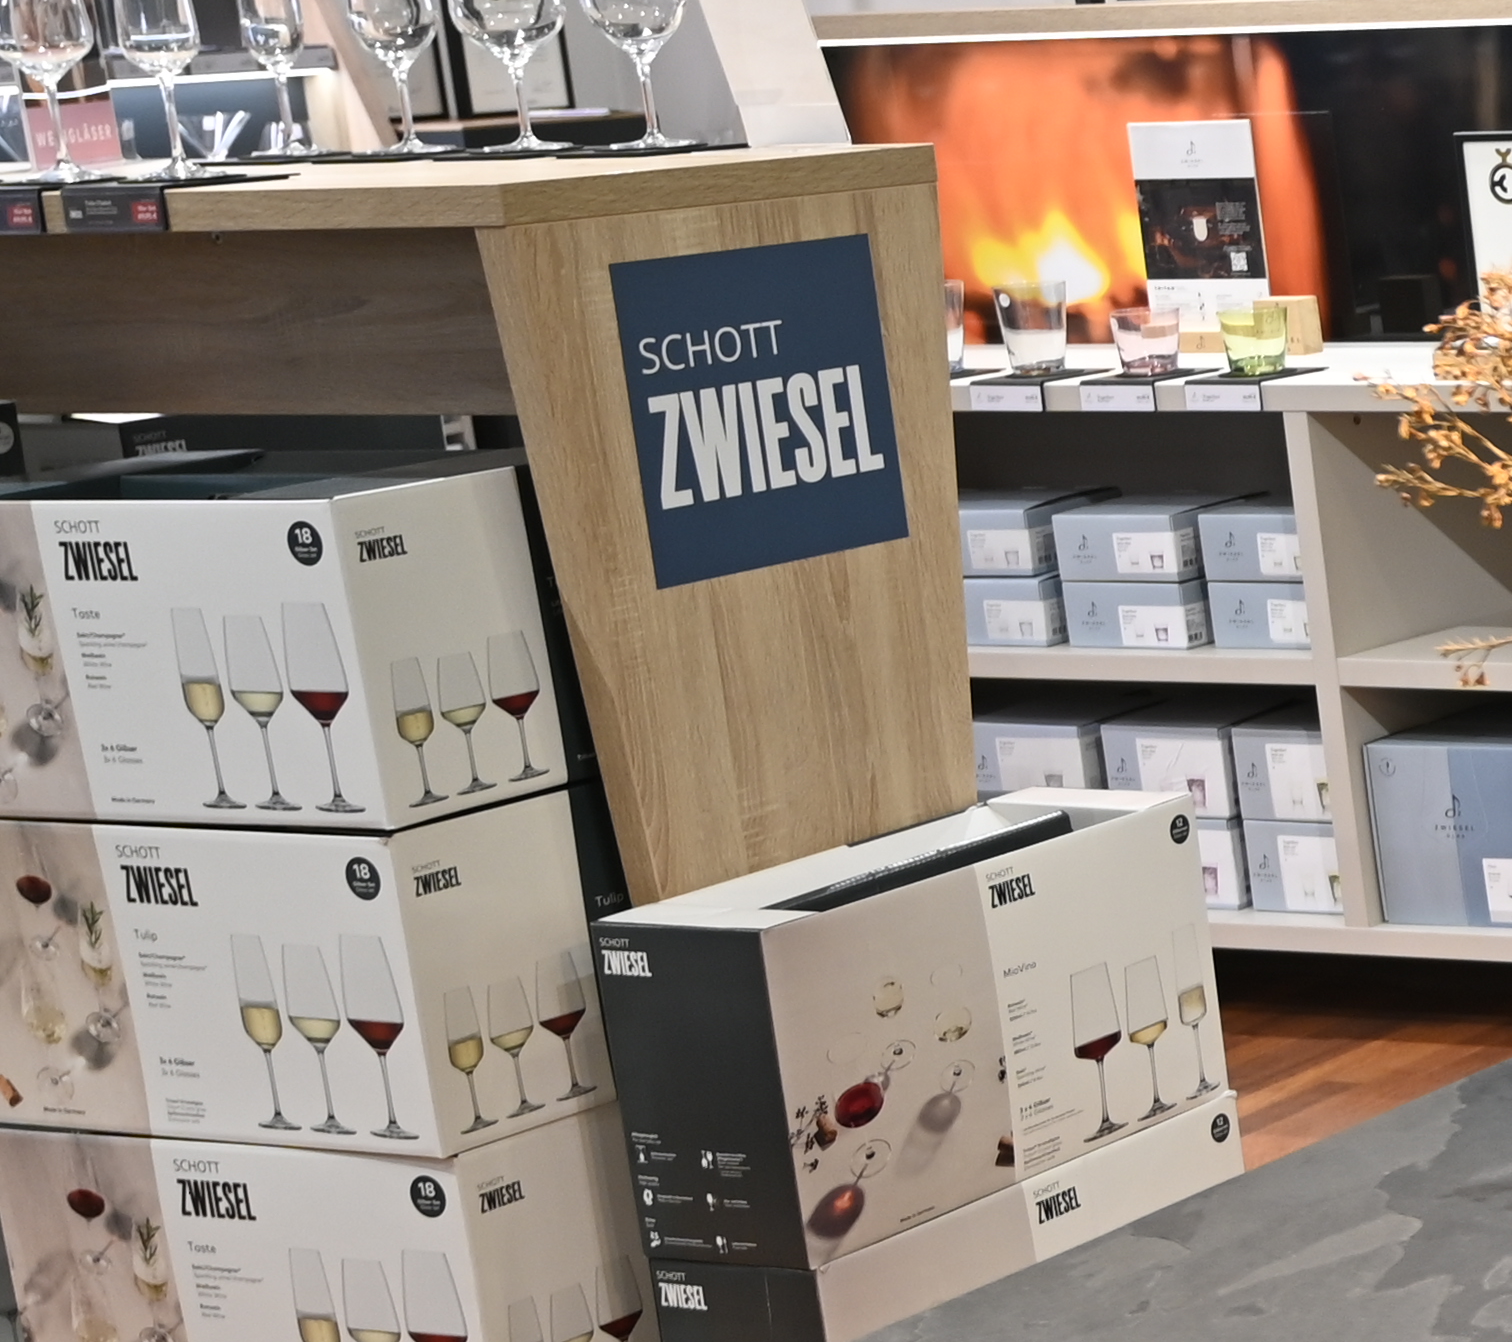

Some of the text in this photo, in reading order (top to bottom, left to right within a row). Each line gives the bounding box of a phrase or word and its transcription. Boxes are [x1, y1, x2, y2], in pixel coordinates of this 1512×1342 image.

[35, 123, 113, 148] WEGLÄSER
[638, 319, 783, 375] SCHOTT
[647, 364, 886, 510] ZWIESEL
[53, 519, 100, 534] SCHOTT
[294, 527, 313, 544] 18
[357, 534, 408, 563] ZWIESEL
[58, 541, 139, 581] ZWIESEL
[71, 607, 100, 619] Taste
[115, 844, 161, 859] SCHOTT
[352, 863, 371, 879] 18
[985, 866, 1015, 883] SCHOTT
[119, 864, 199, 907] ZWIESEL
[413, 865, 462, 898] ZWIESEL
[594, 891, 625, 908] Tulip
[987, 873, 1036, 909] ZWIESEL
[133, 928, 158, 943] Tulip
[598, 937, 630, 948] SCHOTT
[601, 949, 653, 978] ZWIESEL
[1002, 961, 1037, 979] MioVino
[172, 1158, 220, 1174] SCHOTT
[418, 1181, 436, 1198] 18
[479, 1179, 526, 1215] ZWIESEL
[176, 1178, 257, 1222] ZWIESEL
[1035, 1186, 1082, 1225] ZWIESEL
[187, 1240, 217, 1254] Taste
[656, 1270, 686, 1282] SCHOTT
[658, 1281, 708, 1311] ZWIESEL
